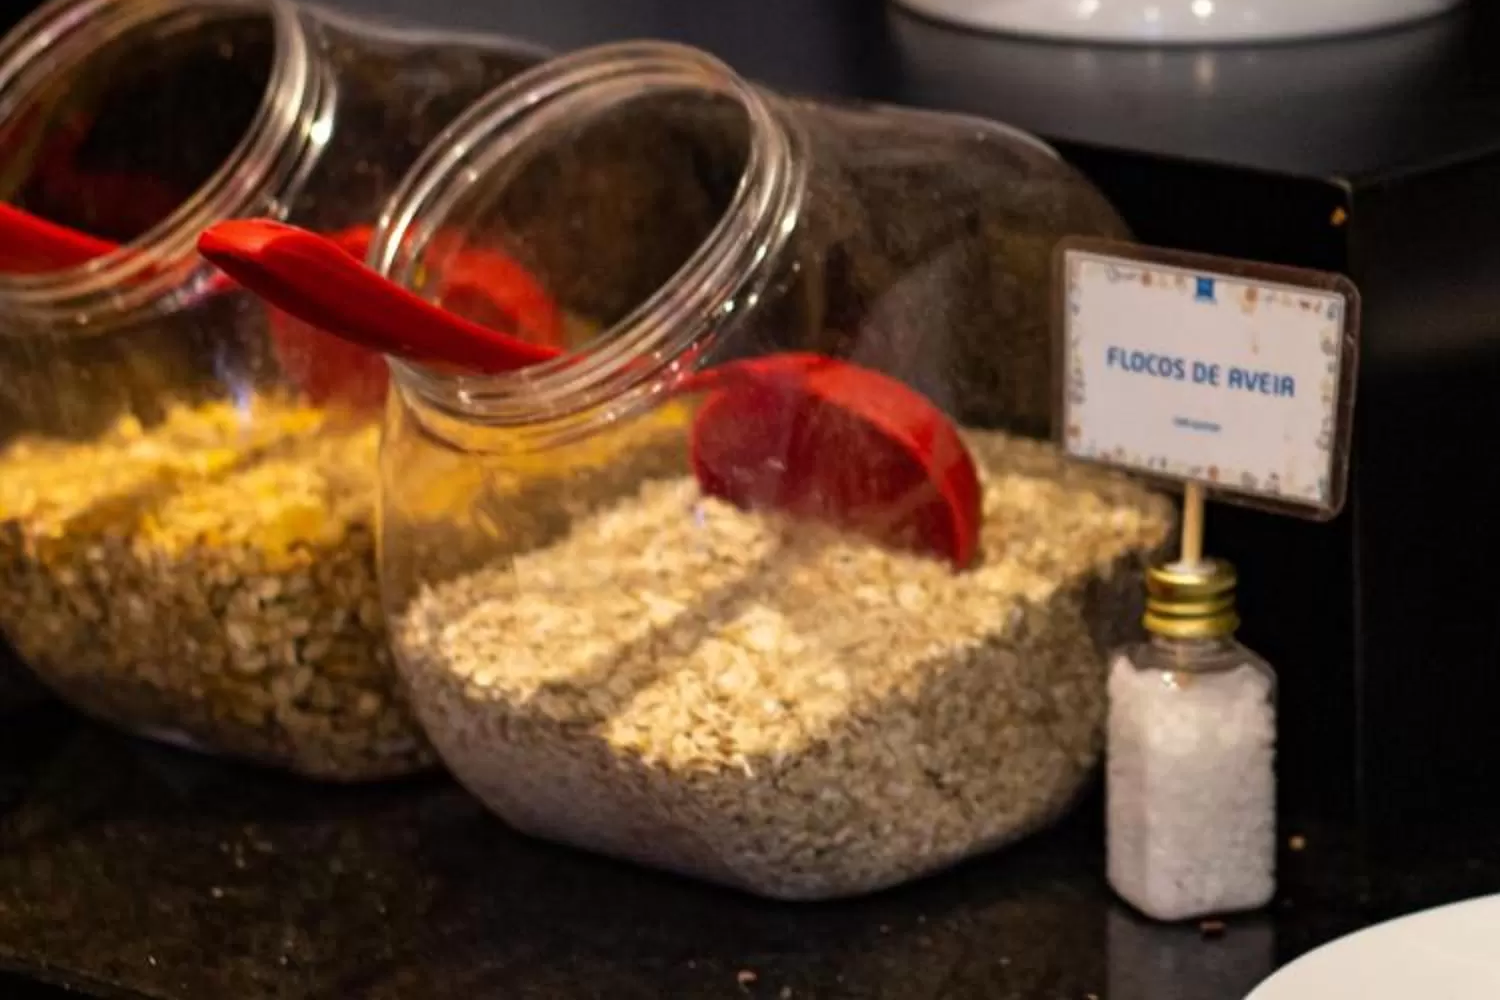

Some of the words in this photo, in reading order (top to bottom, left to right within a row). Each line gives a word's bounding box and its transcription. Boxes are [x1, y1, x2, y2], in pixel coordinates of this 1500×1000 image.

[1106, 345, 1185, 381] FLOCOS
[1192, 360, 1220, 387] DE
[1228, 367, 1295, 398] AVEIA
